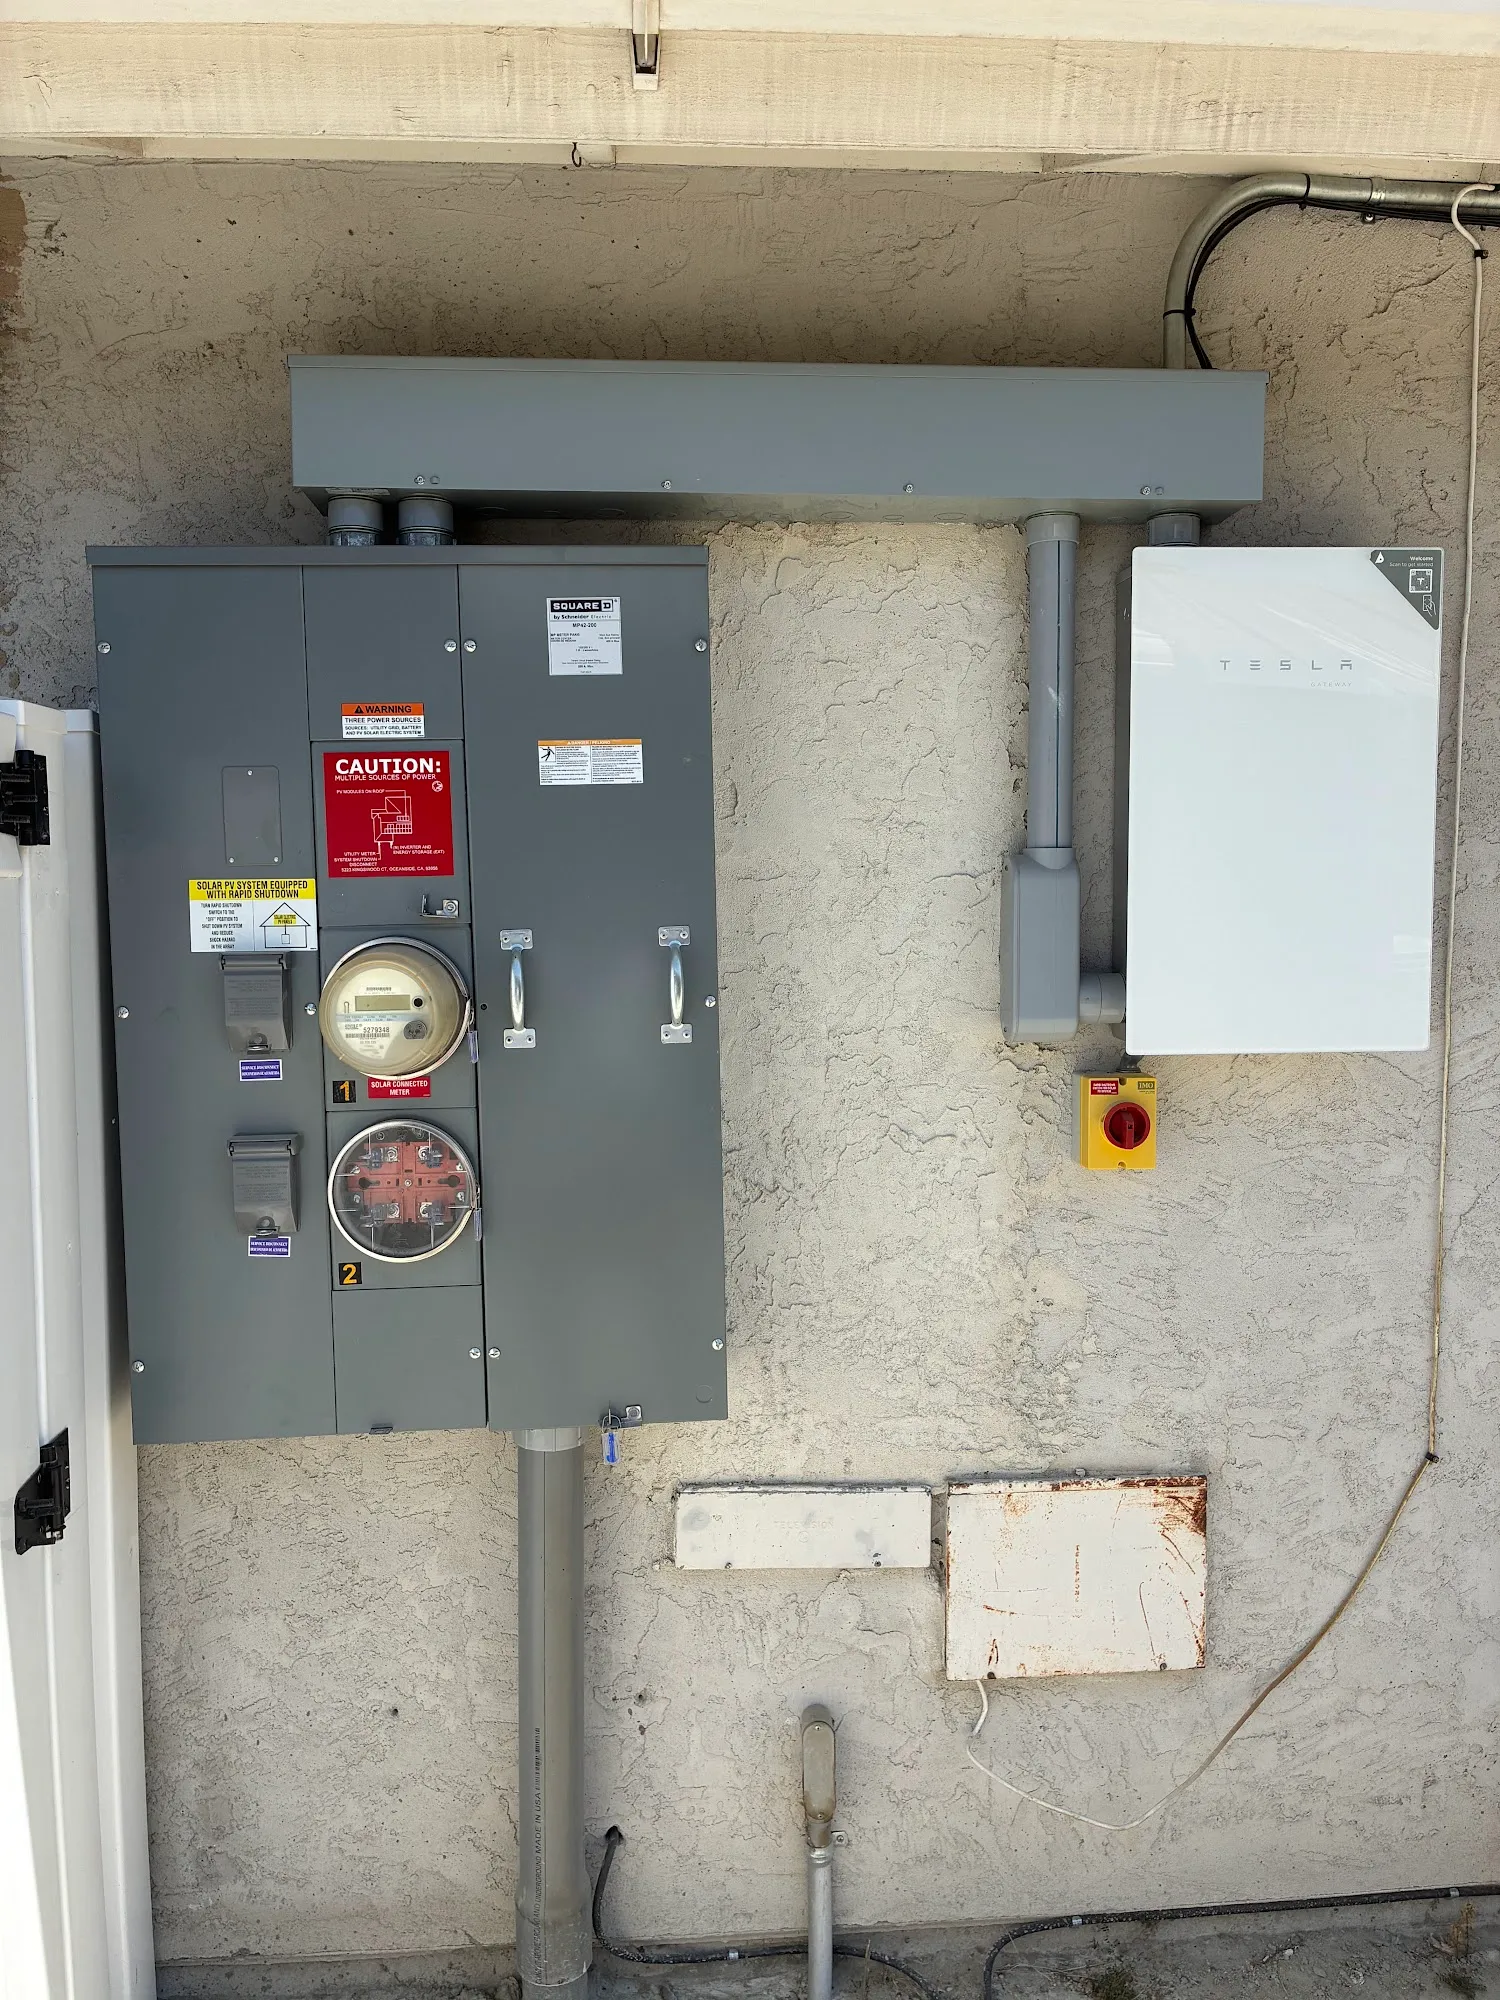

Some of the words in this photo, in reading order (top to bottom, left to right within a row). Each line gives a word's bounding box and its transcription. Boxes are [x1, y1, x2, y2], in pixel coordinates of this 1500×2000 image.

[553, 602, 600, 610] SQUARE
[1220, 659, 1352, 670] TESLA
[365, 705, 412, 714] WARNING
[335, 758, 441, 775] CAUTION:
[197, 882, 222, 890] SOLAR
[225, 881, 235, 890] PV
[237, 881, 267, 889] SYSTEM
[270, 880, 308, 889] EQUIPPED
[207, 890, 226, 899] WITH
[229, 890, 252, 898] RAPID
[255, 890, 299, 898] SHUTDOWN
[340, 1081, 350, 1101] 1
[342, 1264, 357, 1284] 2
[535, 1814, 542, 1824] IN
